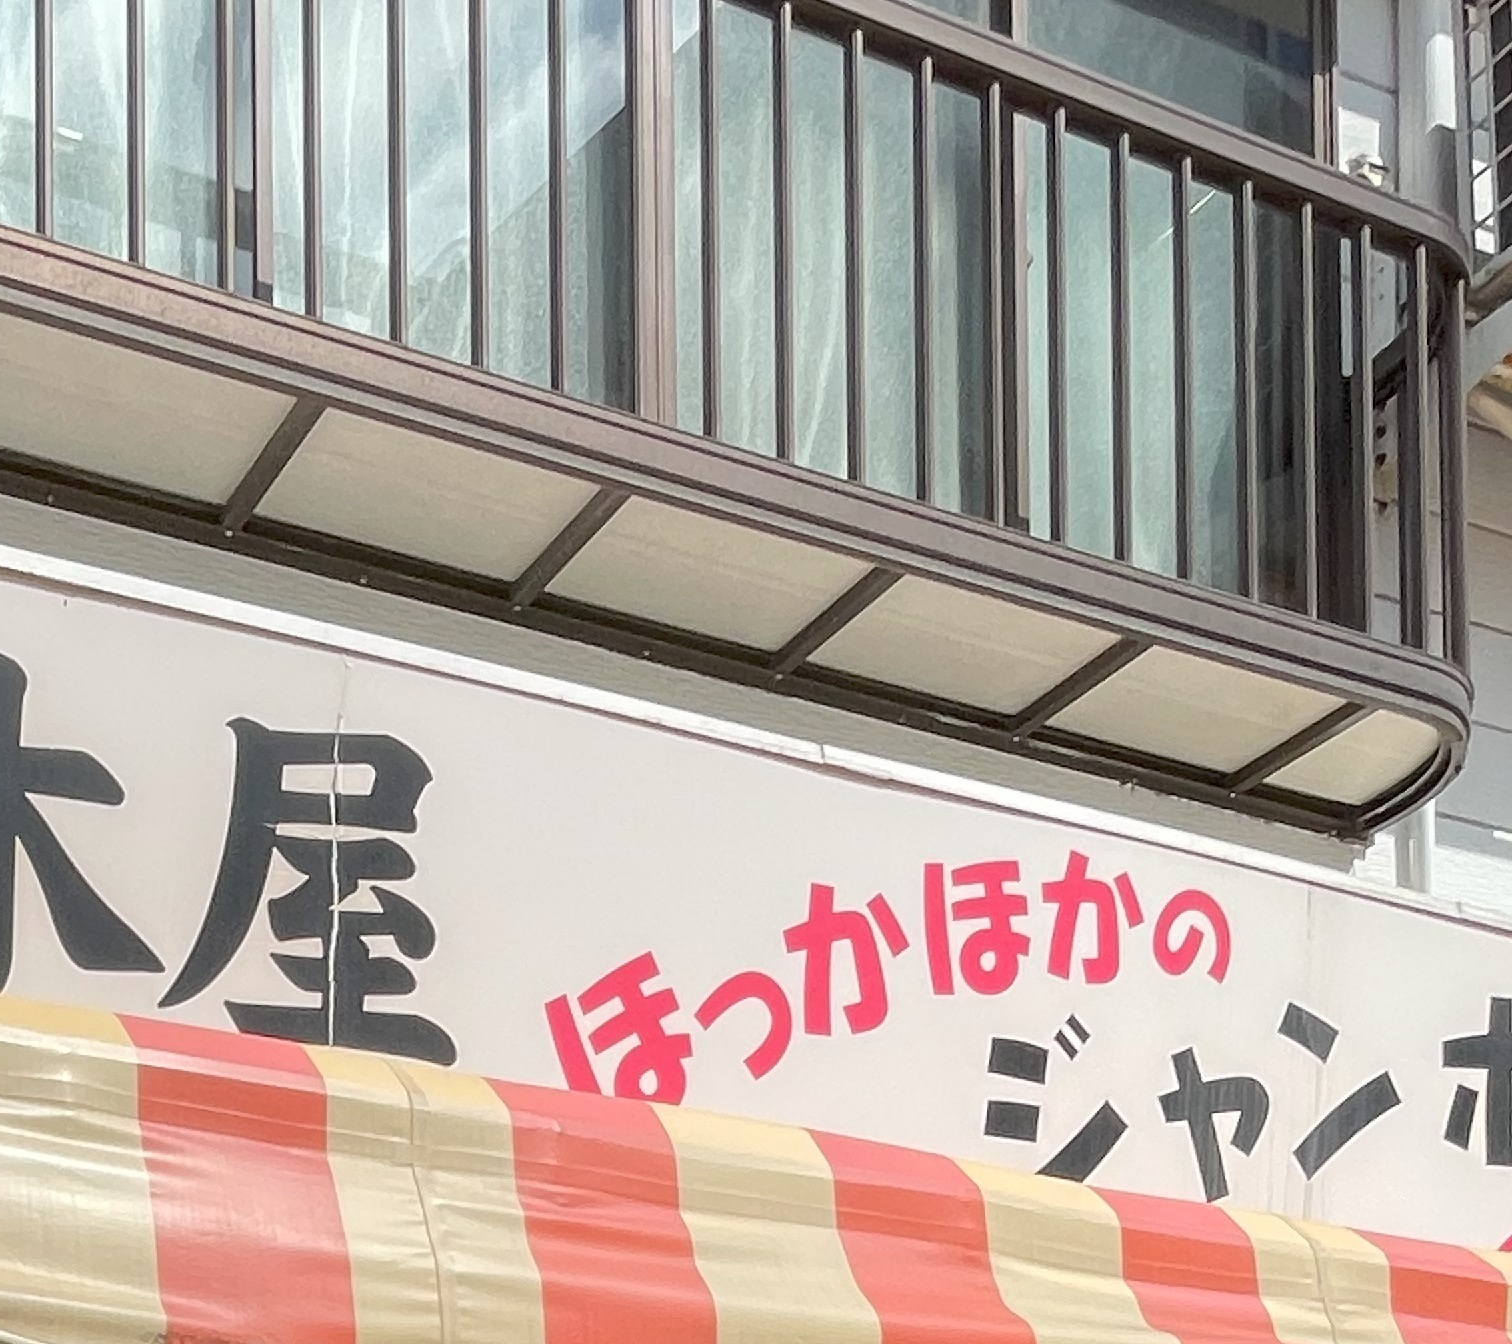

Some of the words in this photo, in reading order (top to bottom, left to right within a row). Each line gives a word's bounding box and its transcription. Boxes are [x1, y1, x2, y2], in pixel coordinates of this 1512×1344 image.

[543, 848, 1232, 1106] ほっかほかの
